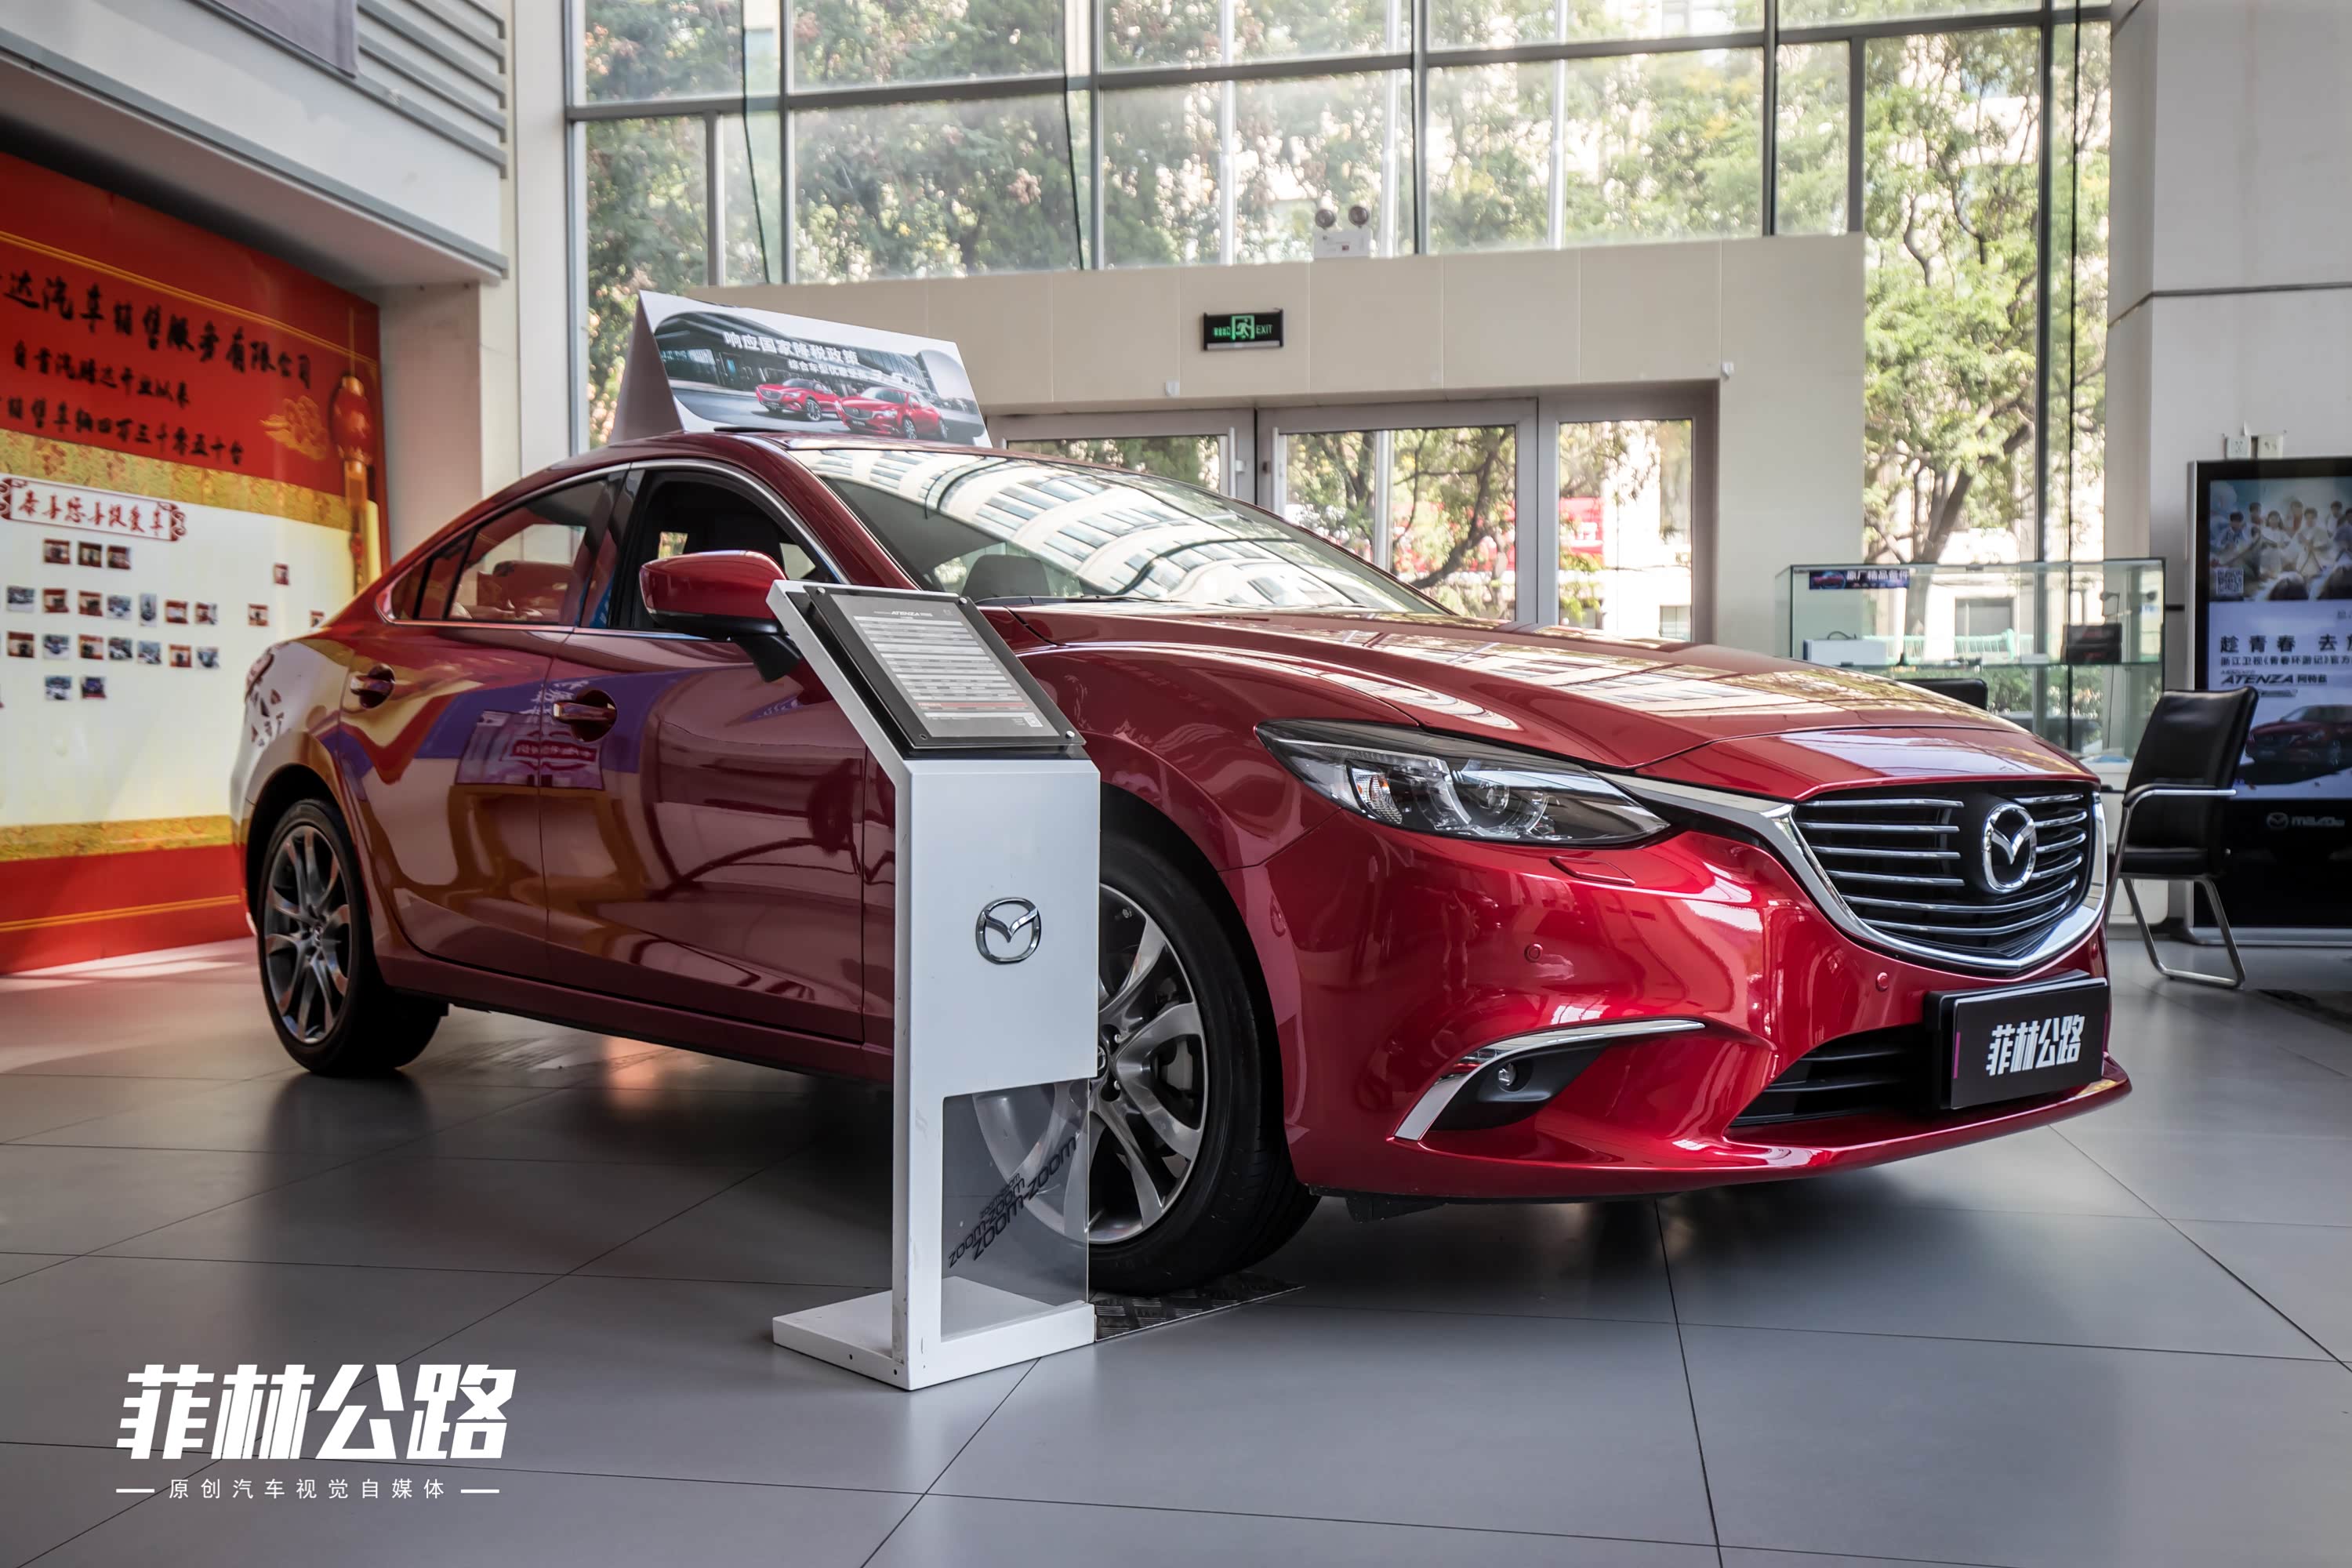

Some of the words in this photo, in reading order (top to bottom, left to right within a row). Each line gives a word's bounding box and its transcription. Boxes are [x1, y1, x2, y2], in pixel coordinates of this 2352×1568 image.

[1256, 324, 1273, 335] EXIT
[722, 331, 861, 365] 响应国家降税政策
[2220, 655, 2352, 666] 浙江卫视《青春环游记》官方
[2221, 674, 2294, 684] ATENZA
[1986, 1014, 2085, 1076] 菲林公路
[972, 1136, 1077, 1261] zoom-zoom
